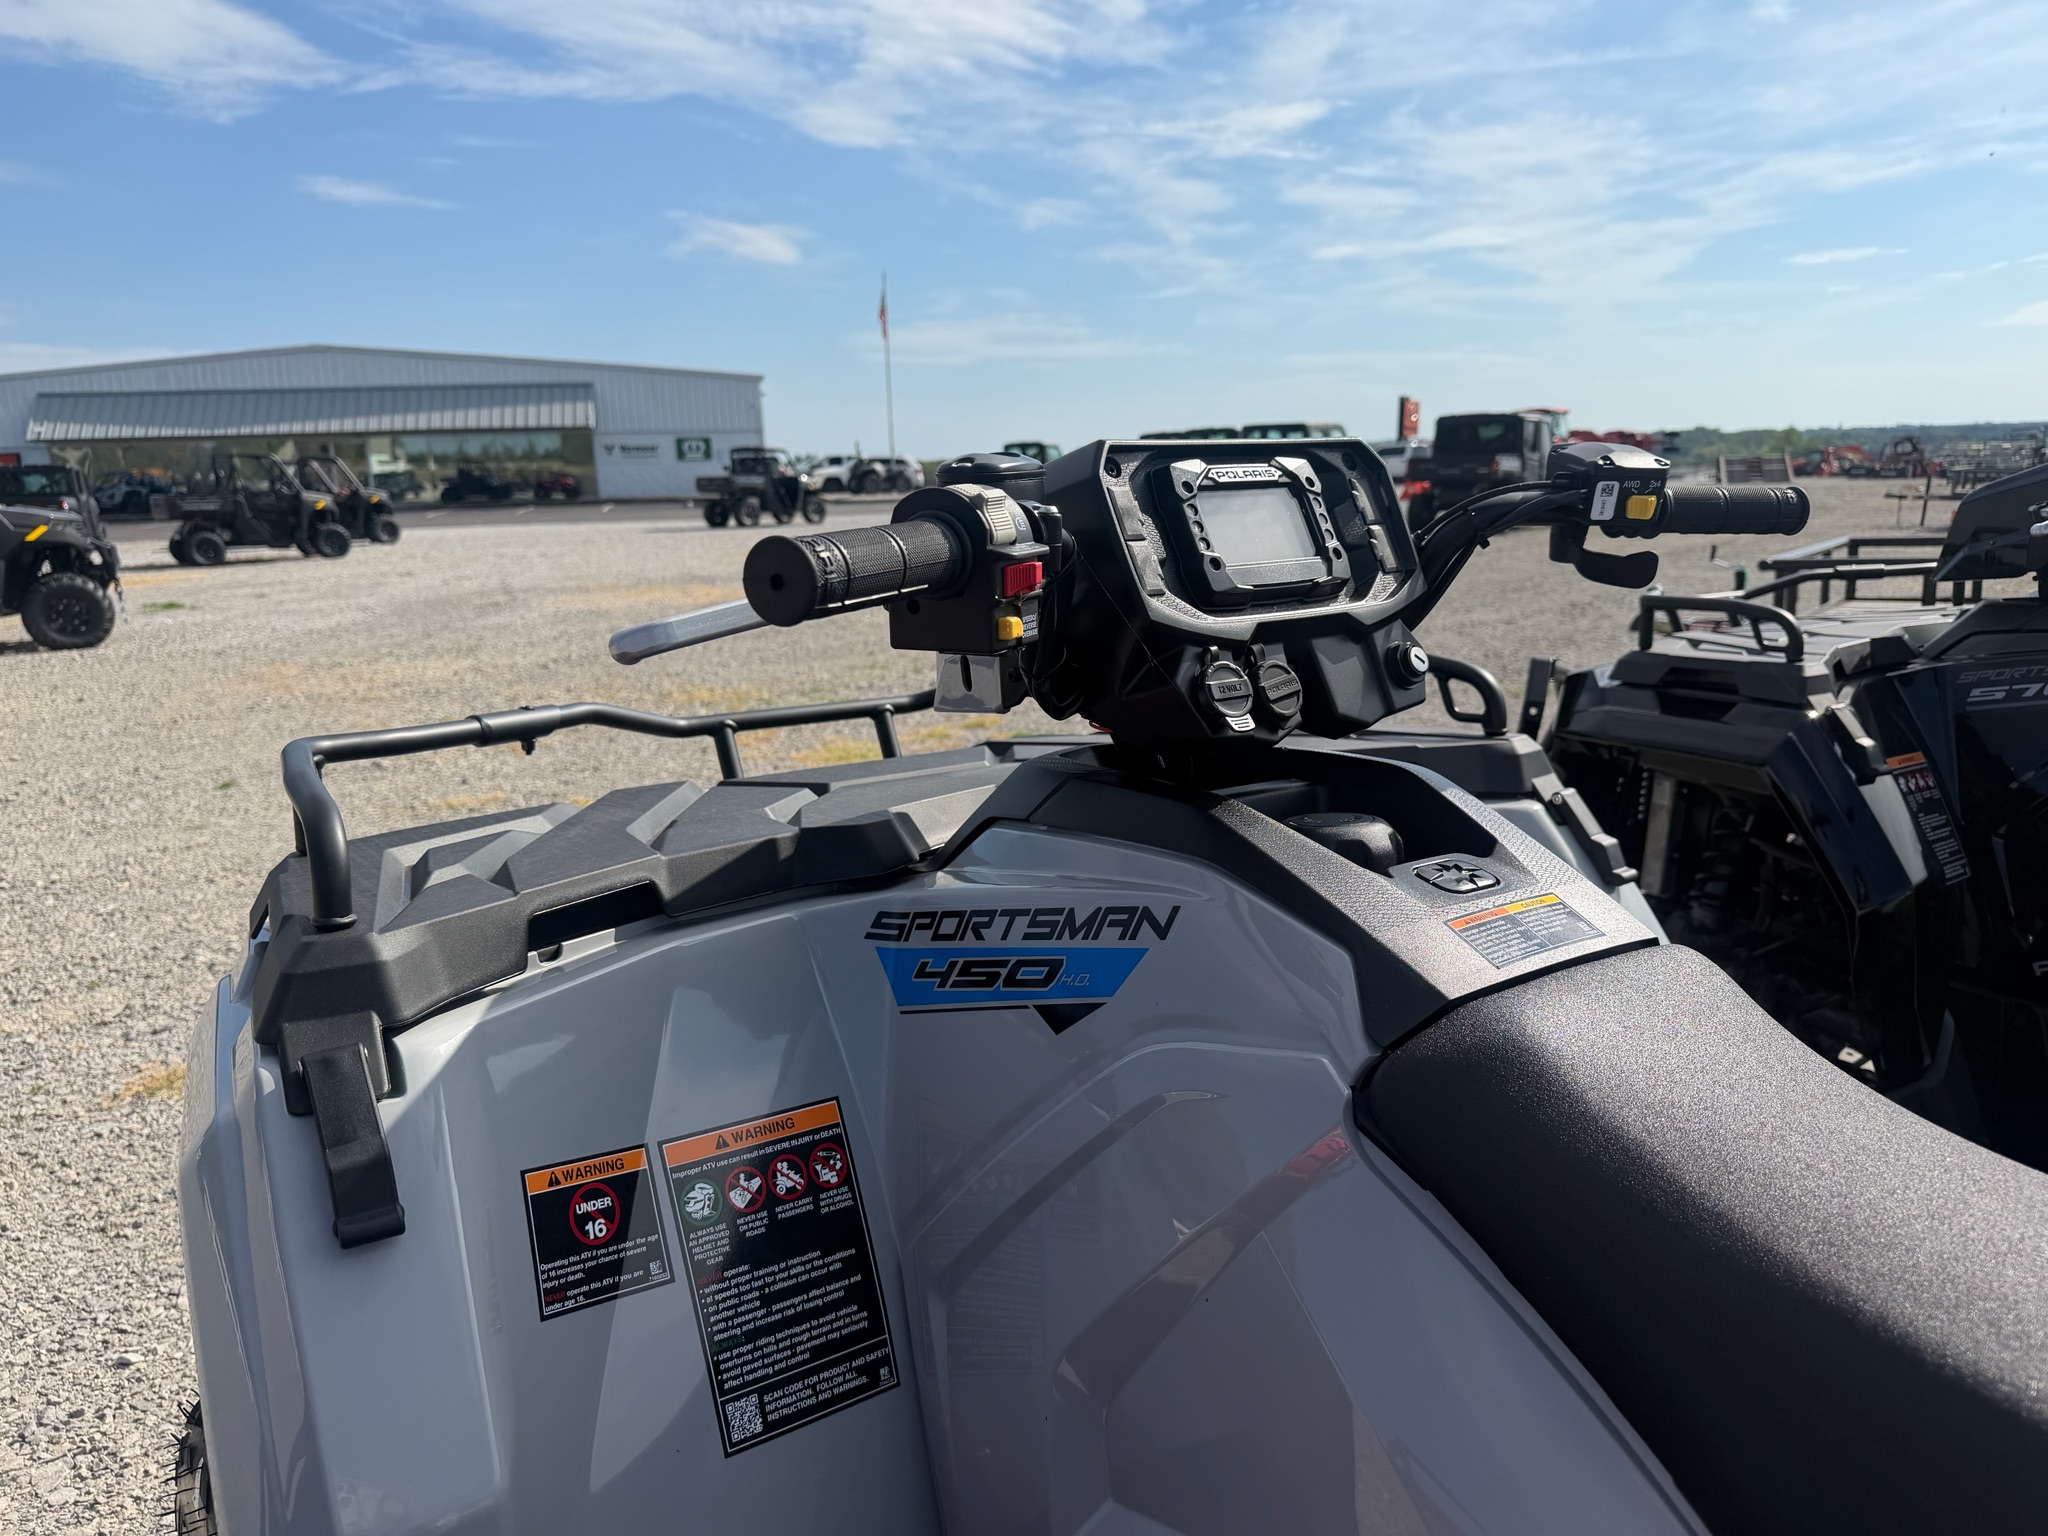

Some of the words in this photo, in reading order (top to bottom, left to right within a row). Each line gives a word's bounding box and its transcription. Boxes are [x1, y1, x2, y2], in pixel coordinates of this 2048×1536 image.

[1216, 469, 1276, 480] POLARIS
[1623, 480, 1640, 488] AWD
[1649, 480, 1661, 488] 2x4
[1218, 686, 1226, 694] 12
[1226, 684, 1243, 694] VOLT
[1266, 679, 1299, 696] POLARIS
[1966, 682, 2048, 702] 57
[864, 906, 1181, 942] SPORTSMAN
[912, 956, 1066, 991] 450
[1059, 973, 1090, 986] H.O.
[730, 1116, 795, 1143] WARNING
[671, 1165, 701, 1179] Improper
[701, 1161, 716, 1170] ATV
[740, 1149, 758, 1160] result
[764, 1141, 790, 1153] SEVERE
[790, 1135, 813, 1146] INJURY
[820, 1127, 841, 1138] DEATH
[562, 1157, 625, 1182] WARNING
[819, 1189, 837, 1199] NEVER
[837, 1186, 848, 1194] USE
[819, 1198, 833, 1206] WITH
[833, 1192, 852, 1202] DRUGS
[575, 1196, 612, 1214] UNDER
[775, 1202, 794, 1212] NEVER
[794, 1196, 813, 1207] CARRY
[777, 1204, 814, 1219] PASSENGERS
[829, 1199, 853, 1211] ALCOHOL
[736, 1214, 755, 1224] NEVER
[756, 1210, 768, 1218] USE
[748, 1217, 768, 1228] PUBLIC
[584, 1217, 607, 1240] 16
[689, 1226, 714, 1238] ALWAYS
[714, 1222, 727, 1231] USE
[697, 1229, 729, 1244] APPROVED
[745, 1226, 766, 1237] ROADS
[540, 1257, 568, 1272] Operating
[569, 1254, 580, 1262] this
[580, 1251, 592, 1259] ATV
[597, 1248, 607, 1256] you
[617, 1239, 635, 1249] under
[636, 1236, 646, 1244] the
[647, 1234, 658, 1242] age
[692, 1241, 716, 1253] HELMET
[716, 1237, 729, 1246] AND
[694, 1245, 730, 1261] PROTECTIVE
[556, 1262, 583, 1275] increases
[584, 1260, 597, 1268] your
[597, 1253, 618, 1263] chance
[626, 1246, 646, 1255] severe
[706, 1254, 723, 1265] GEAR
[542, 1278, 558, 1290] injury
[566, 1271, 585, 1281] death.
[703, 1279, 729, 1293] without
[730, 1273, 753, 1286] proper
[753, 1263, 778, 1278] training
[787, 1250, 820, 1265] instruction
[714, 1286, 738, 1301] speeds
[739, 1283, 750, 1291] too
[751, 1278, 764, 1287] fast
[765, 1274, 774, 1282] for
[775, 1271, 789, 1281] your
[789, 1264, 804, 1274] skills
[813, 1258, 823, 1266] the
[823, 1247, 855, 1263] conditions
[723, 1263, 751, 1278] operate:
[566, 1284, 589, 1297] operate
[590, 1280, 601, 1289] this
[601, 1277, 614, 1286] ATV
[620, 1273, 632, 1282] you
[718, 1296, 740, 1310] public
[740, 1289, 759, 1301] roads
[769, 1277, 797, 1291] collision
[810, 1268, 828, 1277] occur
[828, 1261, 842, 1271] with
[545, 1301, 562, 1311] under
[564, 1298, 576, 1307] age
[577, 1294, 585, 1302] 16.
[709, 1308, 736, 1322] another
[736, 1299, 760, 1312] vehicle
[711, 1321, 727, 1331] with
[733, 1308, 767, 1325] passenger
[771, 1294, 807, 1311] passengers
[807, 1286, 825, 1297] affect
[825, 1278, 849, 1291] balance
[849, 1274, 861, 1283] and
[713, 1326, 741, 1342] steering
[741, 1321, 754, 1331] and
[755, 1311, 782, 1326] increase
[783, 1307, 795, 1316] risk
[803, 1297, 823, 1310] losing
[823, 1289, 844, 1301] control
[718, 1352, 730, 1360] use
[732, 1343, 754, 1356] proper
[755, 1334, 774, 1348] riding
[775, 1321, 810, 1340] techniques
[811, 1318, 818, 1326] to
[818, 1312, 835, 1323] avoid
[836, 1304, 857, 1316] vehicle
[719, 1352, 752, 1369] overturns
[763, 1343, 777, 1353] hills
[778, 1338, 790, 1348] and
[791, 1331, 810, 1344] rough
[811, 1323, 831, 1335] terrain
[832, 1319, 843, 1328] and
[851, 1310, 867, 1320] turns
[722, 1367, 741, 1379] avoid
[742, 1359, 763, 1373] paved
[763, 1348, 791, 1363] surfaces
[795, 1335, 826, 1353] pavement
[827, 1331, 840, 1341] may
[840, 1319, 868, 1336] seriously
[723, 1377, 743, 1389] affect
[743, 1365, 773, 1383] handling
[773, 1360, 786, 1370] and
[787, 1351, 810, 1365] control
[763, 1389, 783, 1402] SCAN
[783, 1380, 803, 1394] CODE
[804, 1375, 818, 1386] FOR
[819, 1362, 850, 1380] PRODUCT
[850, 1356, 865, 1367] AND
[865, 1347, 889, 1362] SAFETY
[765, 1386, 814, 1412] INFORMATION.
[815, 1375, 844, 1391] FOLLOW
[844, 1369, 857, 1380] ALL
[767, 1395, 817, 1422] INSTRUCTIONS
[817, 1389, 832, 1401] AND
[832, 1374, 869, 1395] WARNINGS.
